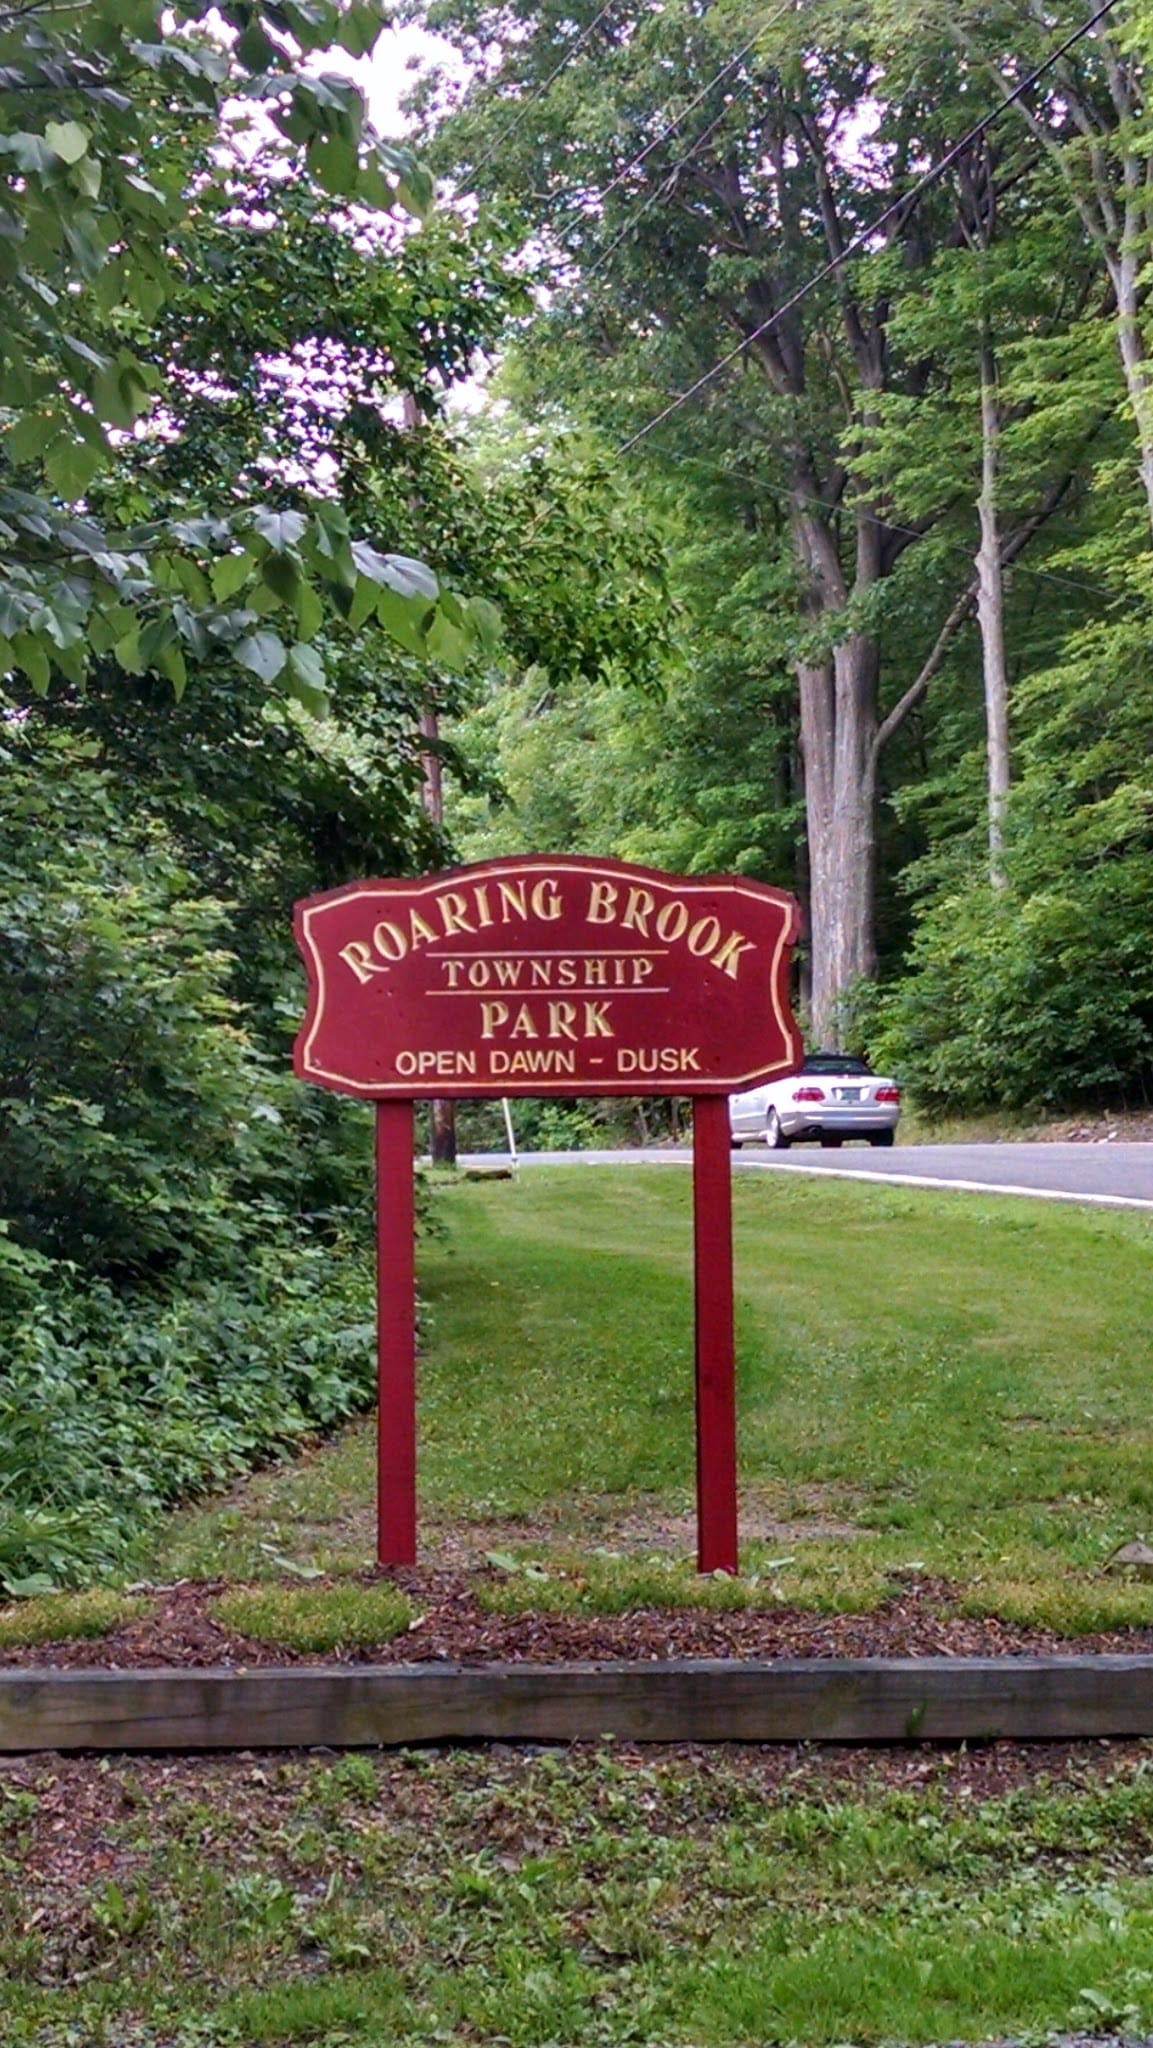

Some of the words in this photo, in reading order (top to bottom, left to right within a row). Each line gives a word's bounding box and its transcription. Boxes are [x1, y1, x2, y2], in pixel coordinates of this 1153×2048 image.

[338, 879, 563, 985] ROARING
[586, 881, 757, 980] BROOK
[441, 959, 654, 987] TOWNSHIP
[480, 1001, 615, 1042] PARK
[395, 1050, 476, 1076] OPEN
[490, 1050, 575, 1074] DAWN
[617, 1048, 701, 1073] DUSK
